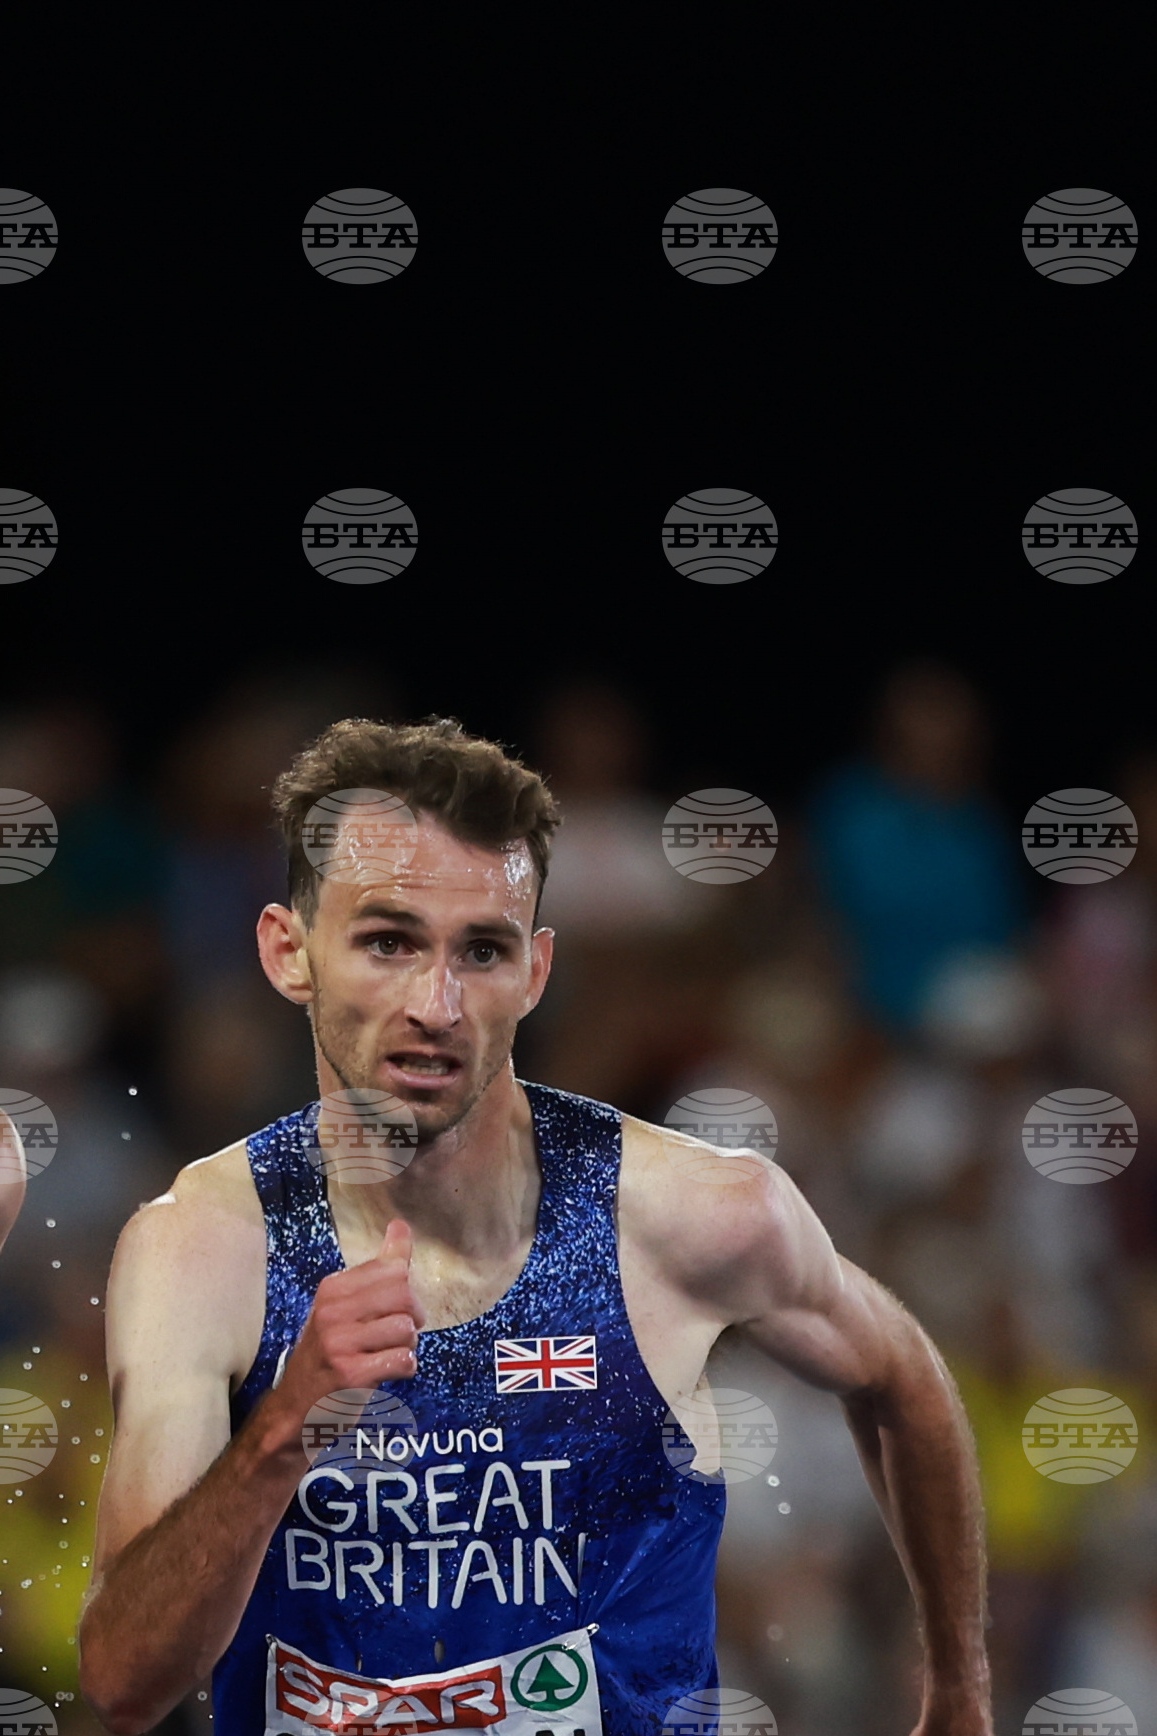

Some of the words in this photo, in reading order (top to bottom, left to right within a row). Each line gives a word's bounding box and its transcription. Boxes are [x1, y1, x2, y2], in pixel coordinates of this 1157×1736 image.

[356, 1427, 504, 1461] Novuna
[298, 1459, 571, 1534] GREAT
[285, 1528, 586, 1610] BRITAIN
[282, 1661, 500, 1729] SPAR
